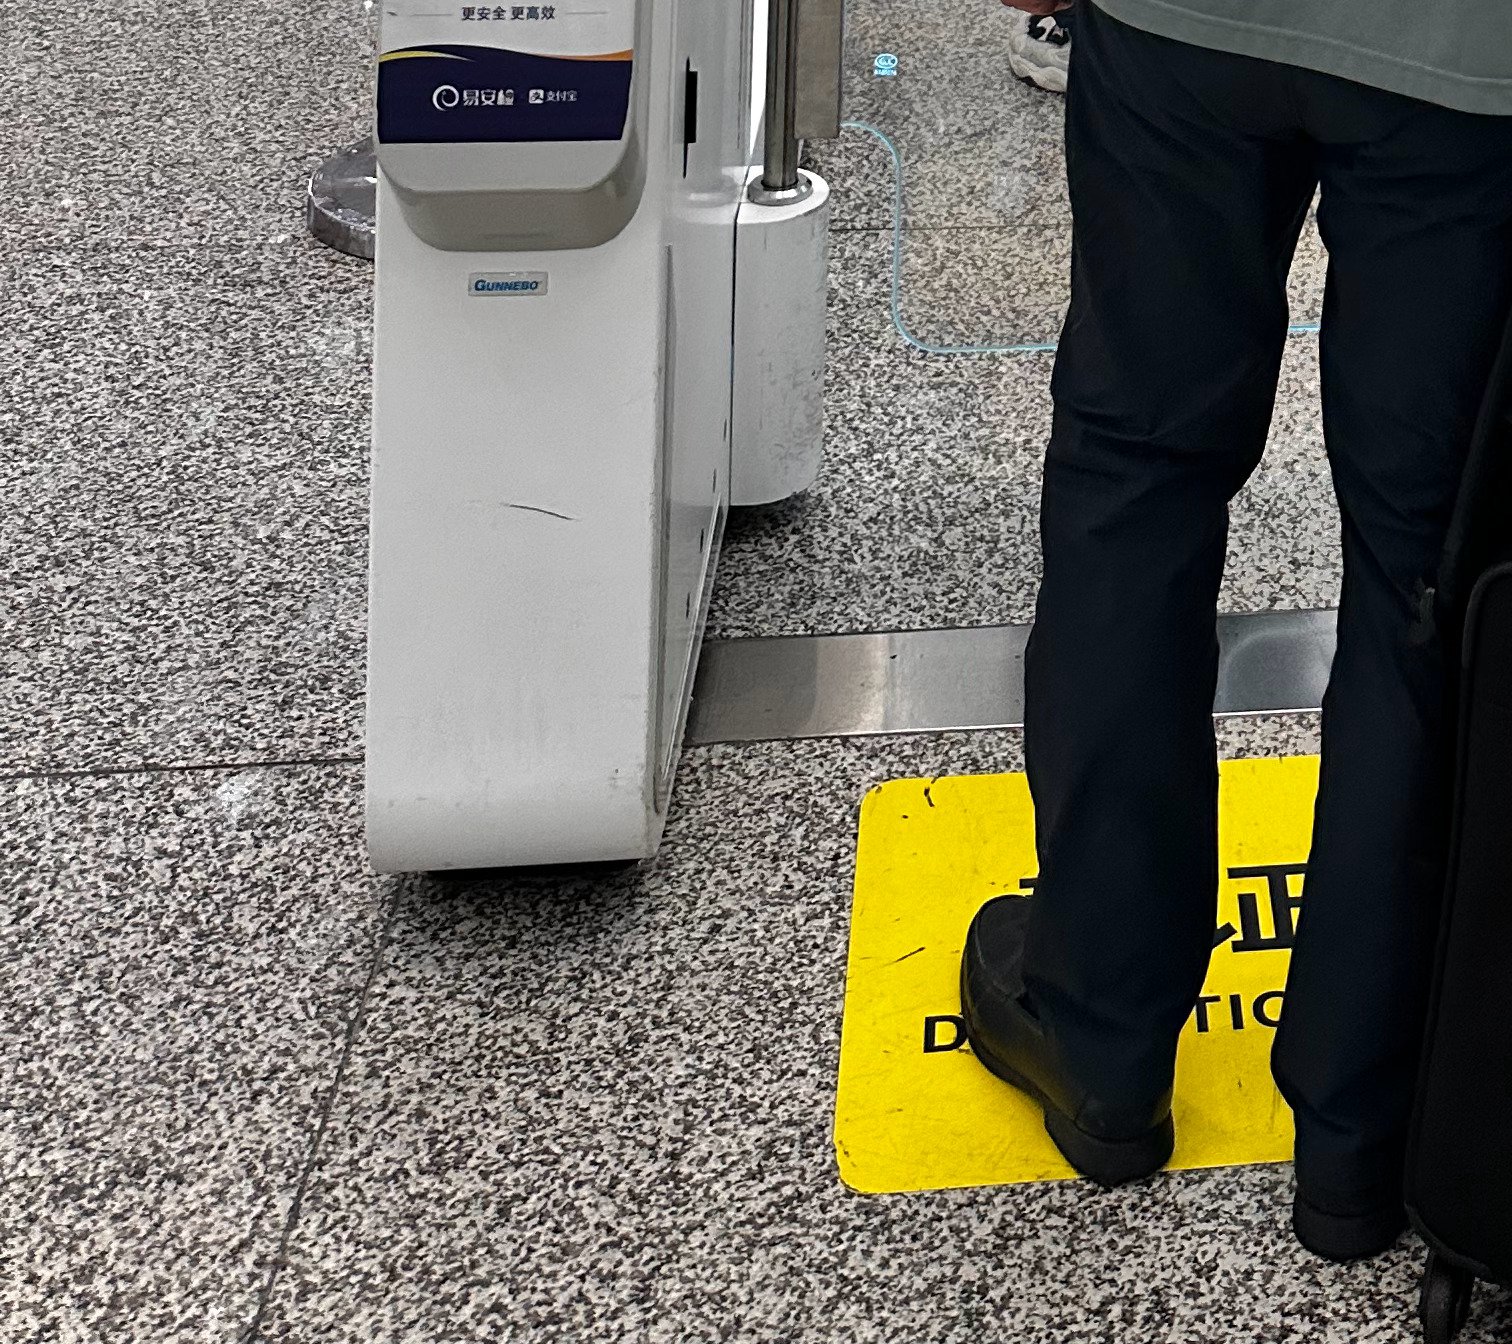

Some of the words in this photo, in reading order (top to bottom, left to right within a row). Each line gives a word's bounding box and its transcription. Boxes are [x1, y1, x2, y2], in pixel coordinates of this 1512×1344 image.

[461, 5, 508, 21] 更安全
[510, 4, 556, 21] 更高效
[473, 278, 540, 292] GUNNEBO
